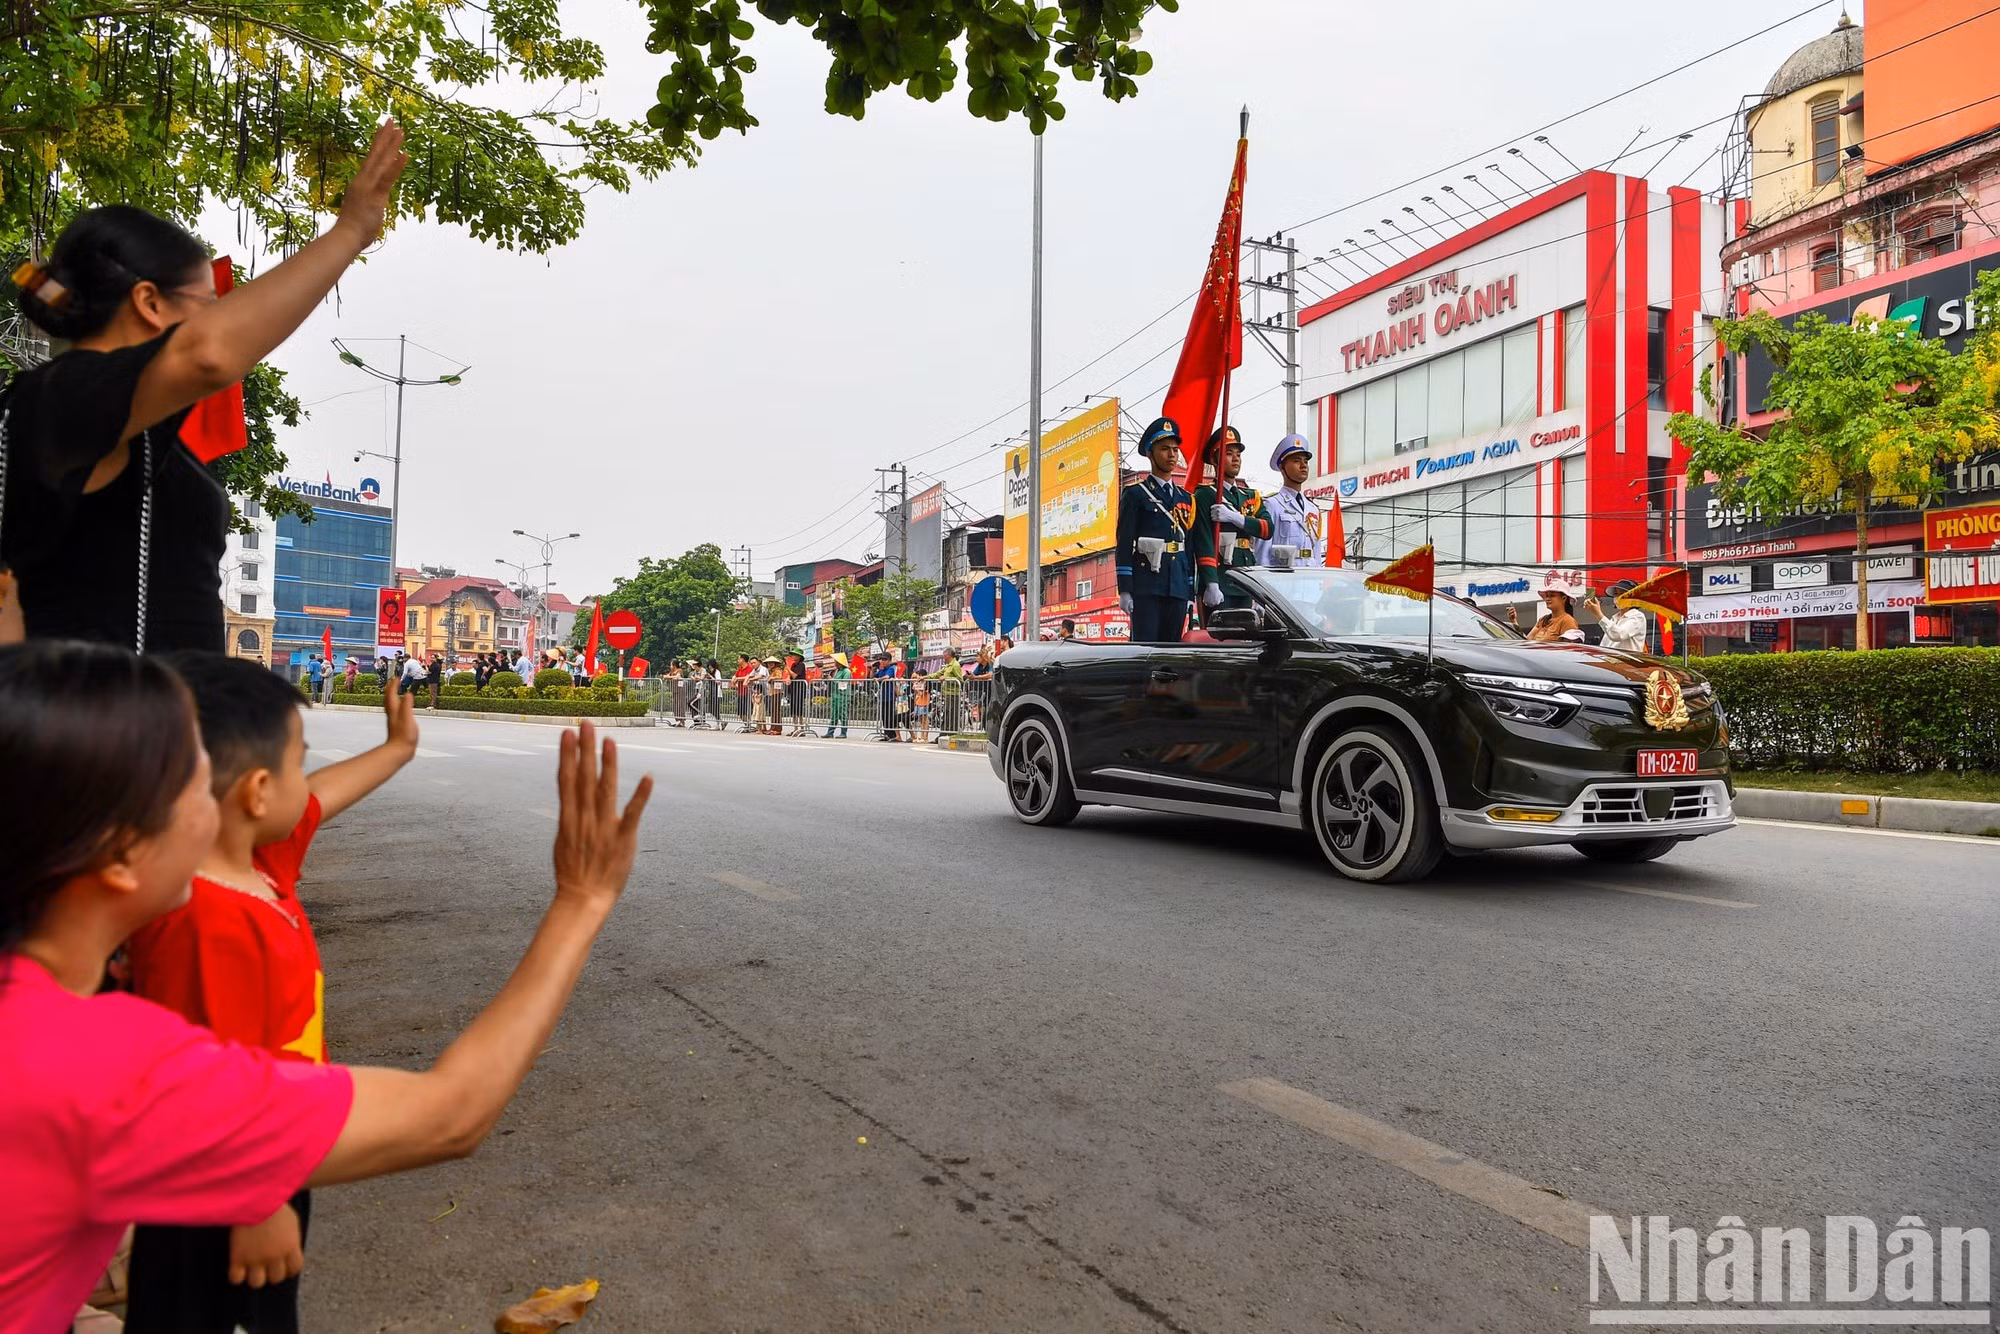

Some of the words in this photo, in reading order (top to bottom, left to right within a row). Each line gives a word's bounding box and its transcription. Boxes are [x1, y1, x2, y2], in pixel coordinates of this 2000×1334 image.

[1387, 283, 1426, 316] SIÊU
[1429, 270, 1459, 297] THỊ
[1341, 312, 1427, 373] THANH
[1434, 273, 1518, 337] OÁNH
[1530, 424, 1581, 448] Canon
[1482, 439, 1521, 461] AQUA
[1426, 450, 1475, 474] DAIKIN
[278, 475, 361, 502] VietinBank
[1008, 476, 1029, 495] Doppe
[1364, 466, 1410, 490] HITACHI
[1013, 493, 1028, 509] herz
[1936, 513, 2000, 540] PHÒNG
[1702, 550, 1718, 560] 898
[1718, 546, 1736, 558] Phố
[1735, 546, 1742, 556] 6
[1767, 540, 1796, 553] Thanh
[1868, 556, 1906, 569] UAWEI
[1468, 577, 1530, 598] Panasonic
[1709, 573, 1740, 587] DELL
[1721, 608, 1747, 619] 2.99
[1748, 606, 1780, 618] Triệu
[1792, 602, 1811, 614] Đổi
[1813, 603, 1836, 614] máy
[1838, 601, 1853, 611] 2G
[1887, 596, 1927, 608] 300K
[1750, 593, 1782, 604] Redmi
[1784, 590, 1800, 602] A3
[1639, 753, 1696, 774] TM-02-70
